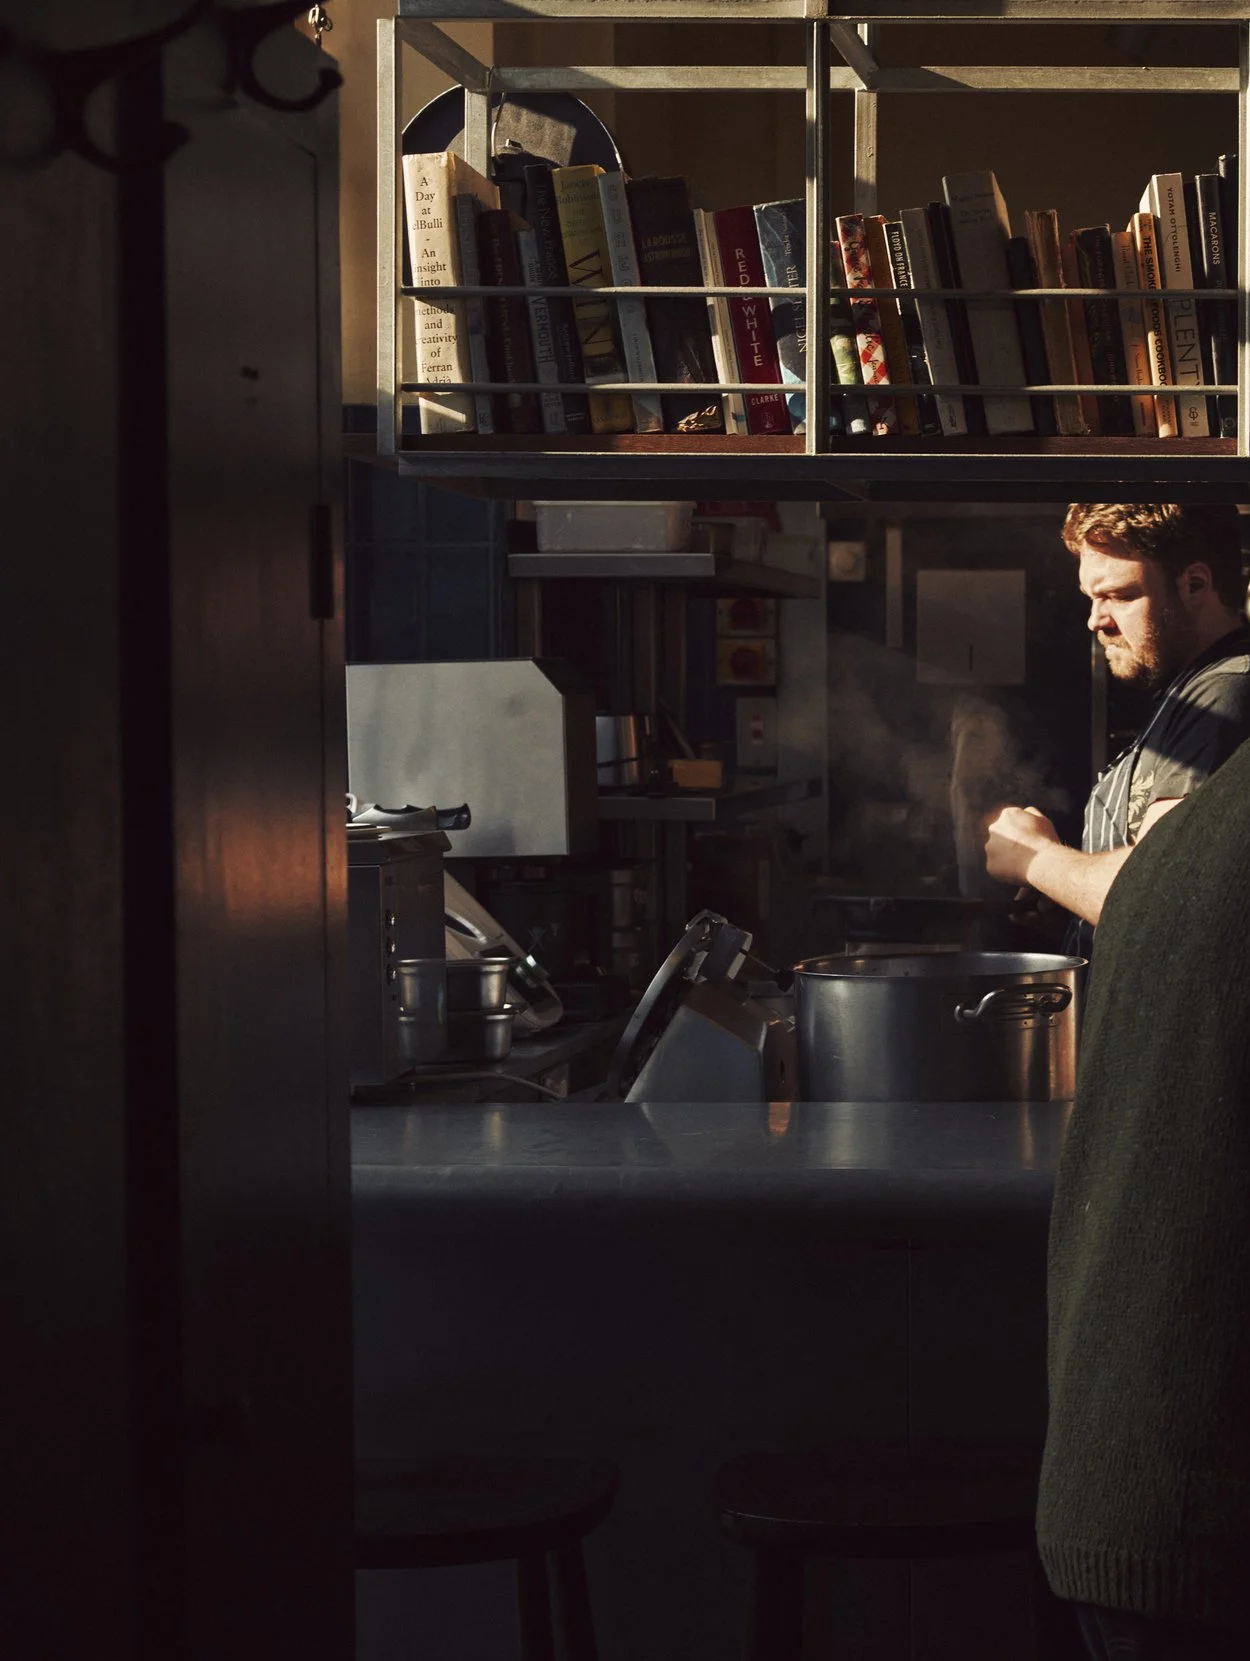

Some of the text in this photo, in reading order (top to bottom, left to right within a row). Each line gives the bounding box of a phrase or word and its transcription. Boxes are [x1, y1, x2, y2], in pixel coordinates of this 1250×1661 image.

[420, 176, 429, 186] A
[415, 191, 436, 203] Day
[421, 207, 432, 216] at
[412, 218, 443, 230] elBulli
[1167, 187, 1181, 273] YOTAM OTTOLENGHI
[1143, 236, 1153, 255] THE
[1209, 211, 1221, 266] MACARONS
[422, 248, 436, 258] An
[891, 231, 909, 289] FLOYD ON FRANCE
[414, 262, 447, 274] insight
[735, 248, 751, 287] RED
[1146, 257, 1158, 290] SMOKE
[420, 276, 441, 287] into
[786, 265, 804, 313] SLTER
[424, 318, 443, 330] and
[531, 296, 556, 365] VERMOUTH
[417, 333, 459, 345] eativity
[742, 304, 764, 367] WHITE
[793, 316, 807, 353] NIGEL
[1172, 299, 1200, 386] PLENT
[430, 347, 442, 358] of
[421, 362, 453, 373] Ferran
[1154, 338, 1168, 386] COOKBO
[750, 394, 780, 406] CLARKE
